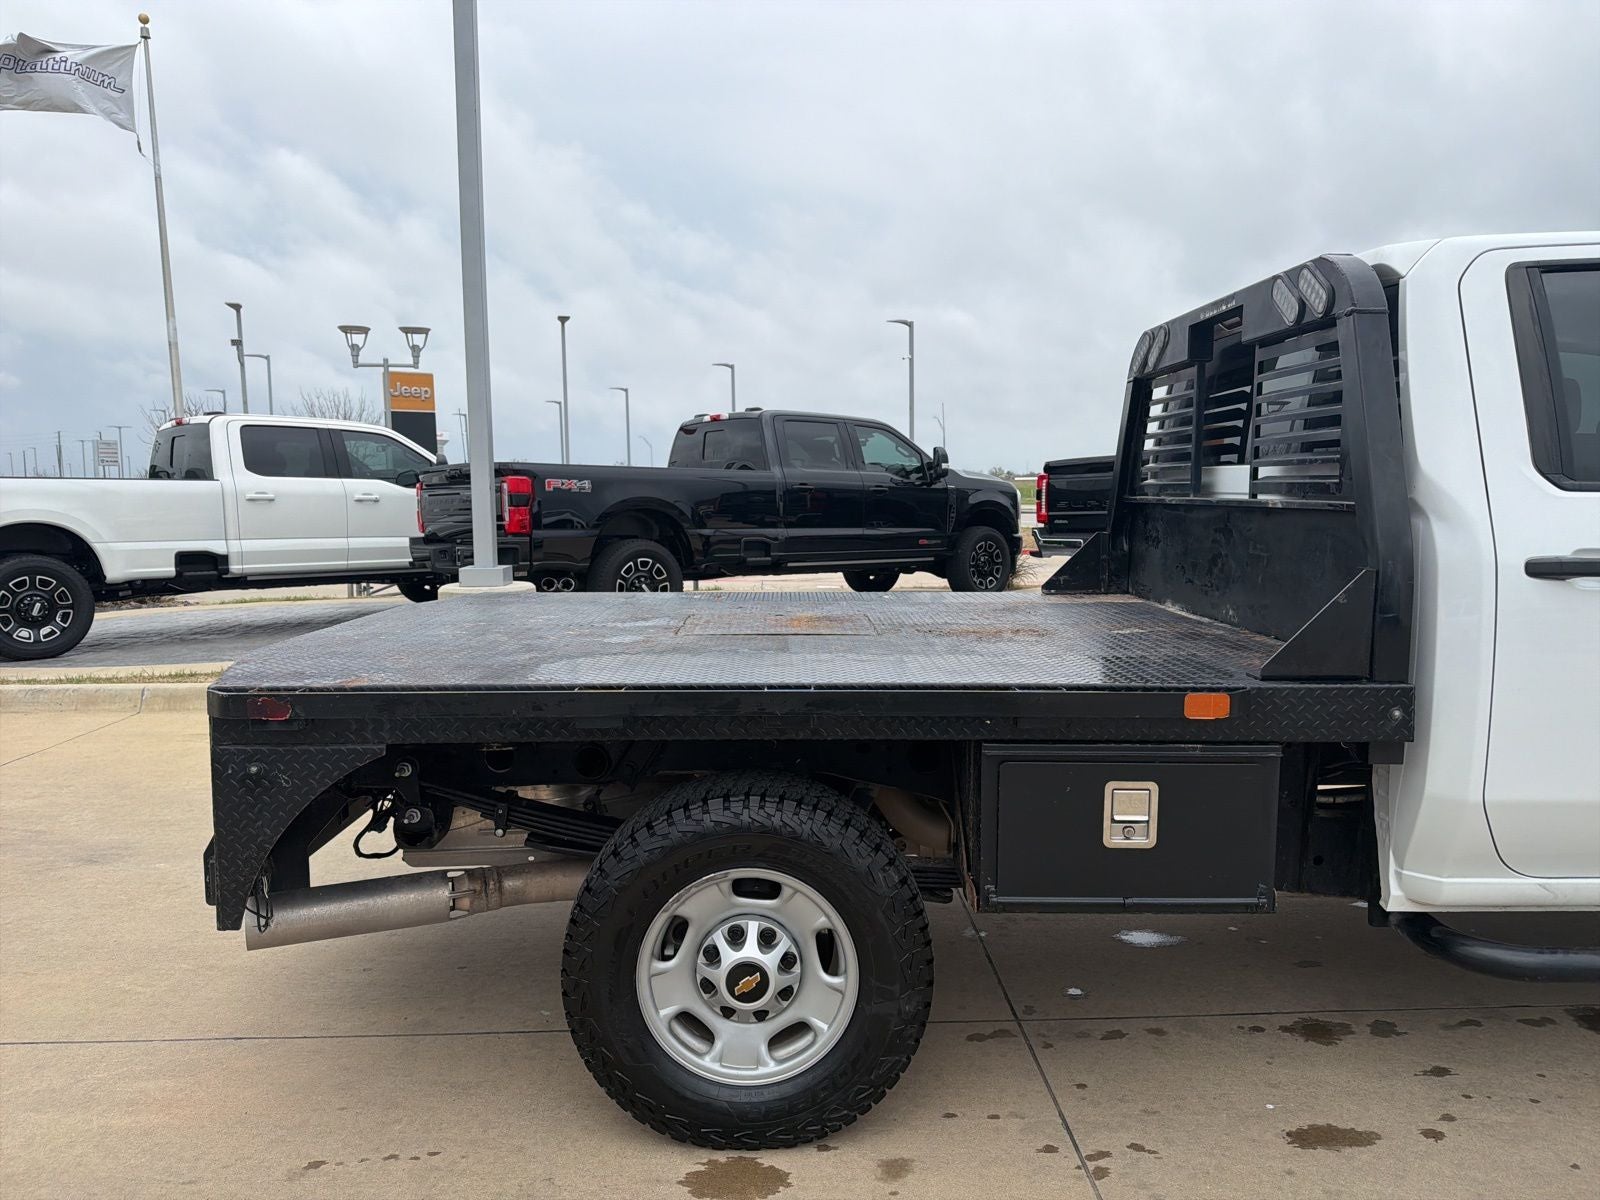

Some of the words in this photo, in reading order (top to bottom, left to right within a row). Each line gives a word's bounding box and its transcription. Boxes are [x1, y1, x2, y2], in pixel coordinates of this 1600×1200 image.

[0, 54, 125, 94] Platinum
[389, 382, 431, 401] Jeep
[545, 478, 592, 492] FX4
